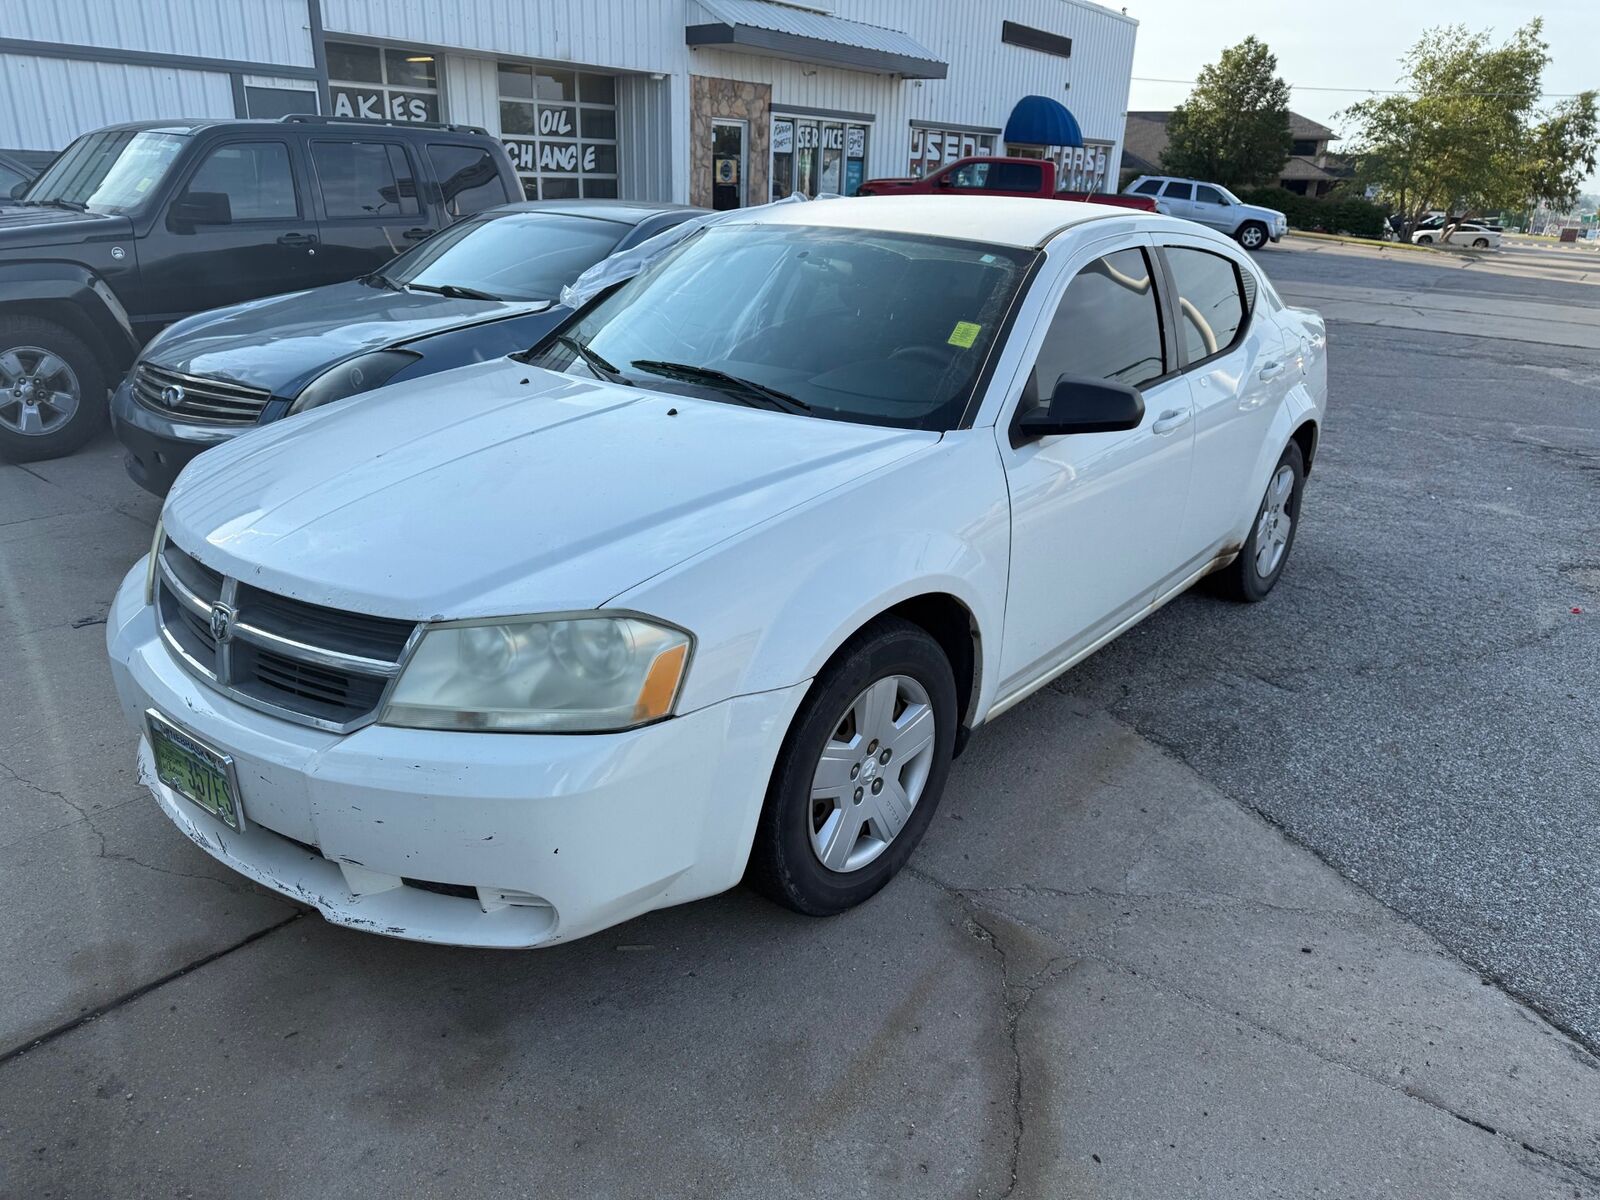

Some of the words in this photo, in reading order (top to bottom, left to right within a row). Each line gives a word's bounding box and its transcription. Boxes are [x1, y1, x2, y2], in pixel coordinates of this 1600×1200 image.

[540, 109, 572, 135] OIL
[798, 126, 843, 149] SERVICE
[911, 132, 975, 162] USED
[505, 142, 595, 171] CHANGE
[168, 729, 210, 762] NEBRASK
[185, 759, 234, 815] 357ES
